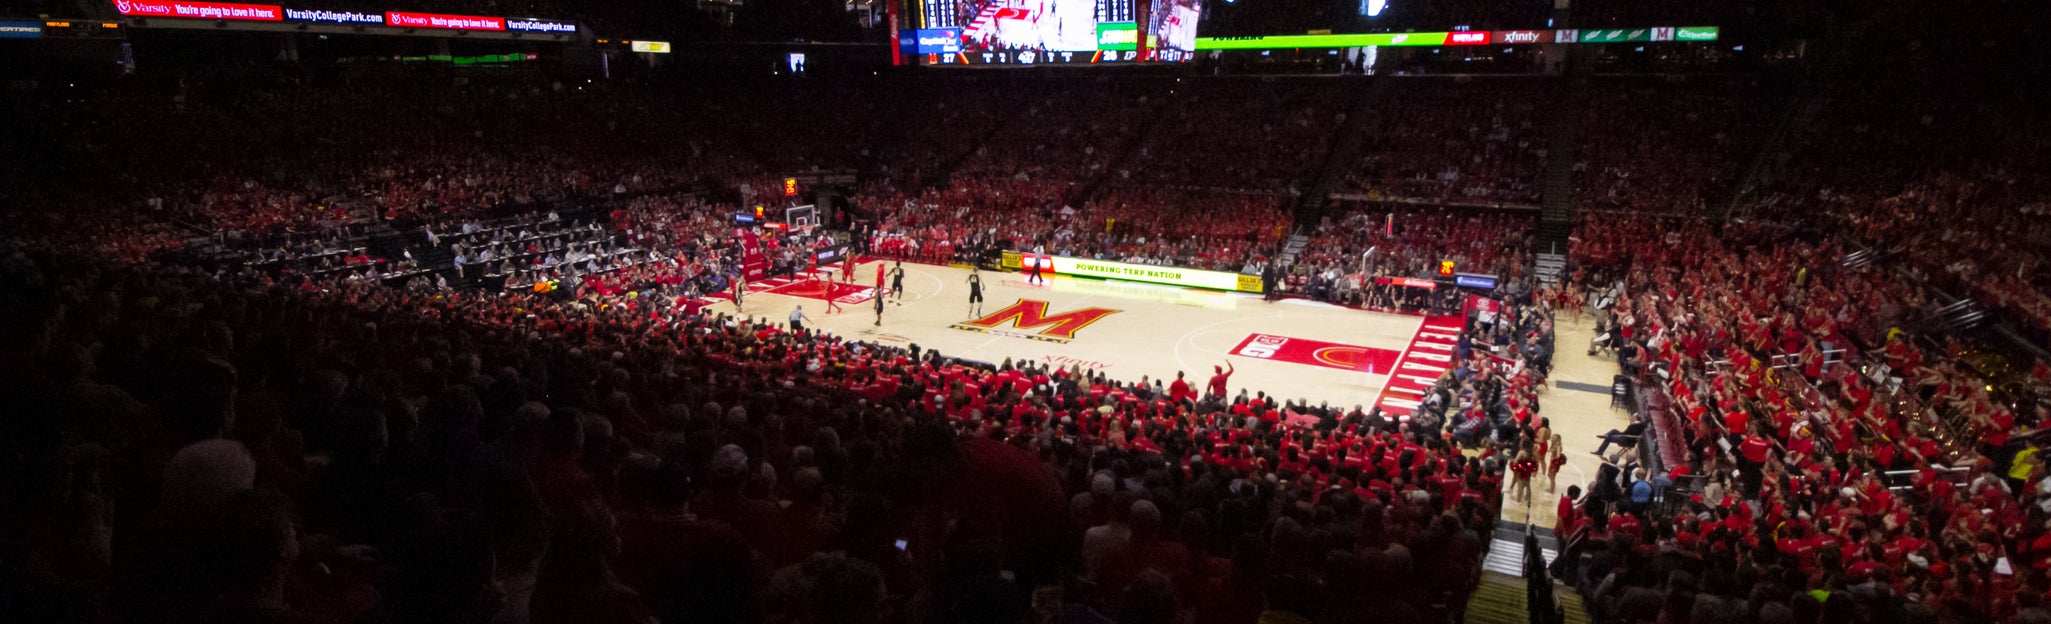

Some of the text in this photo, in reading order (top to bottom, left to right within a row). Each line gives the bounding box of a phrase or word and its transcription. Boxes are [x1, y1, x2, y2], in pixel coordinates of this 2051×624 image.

[132, 3, 171, 14] Varsity
[175, 4, 198, 15] You're
[200, 6, 222, 17] going
[222, 8, 230, 16] to
[231, 7, 247, 16] love
[286, 9, 383, 23] VarsityCollegePark.com
[401, 15, 428, 25] Varsity
[448, 18, 463, 28] going
[470, 19, 481, 28] love
[507, 20, 576, 31] VarsityCollegePark.com
[1504, 31, 1540, 43] xfinity
[1560, 30, 1573, 41] M
[1656, 28, 1669, 39] M
[1076, 263, 1182, 280] POWERING TERP NATION
[959, 298, 1124, 341] M
[1040, 355, 1113, 370] xfinity
